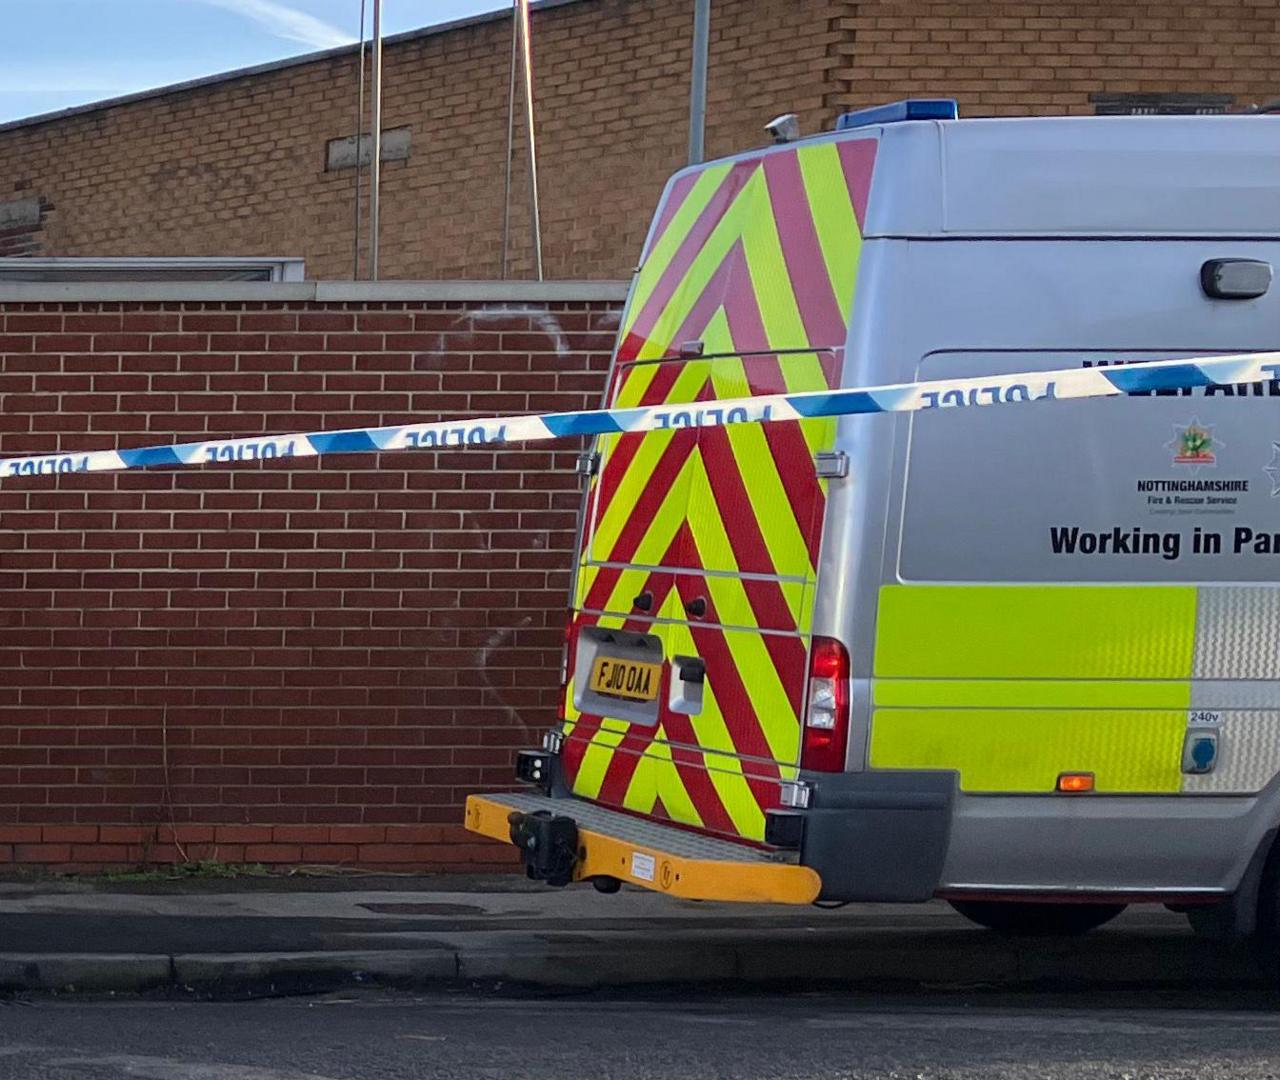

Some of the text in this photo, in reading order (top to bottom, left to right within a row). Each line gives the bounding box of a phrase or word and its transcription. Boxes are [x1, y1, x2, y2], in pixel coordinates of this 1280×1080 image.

[1138, 480, 1248, 492] NOTTINGHAMSHIRE
[1051, 527, 1181, 561] Working
[1193, 527, 1221, 554] in
[598, 662, 652, 695] FJ10 OAA
[1191, 712, 1219, 721] 240v
